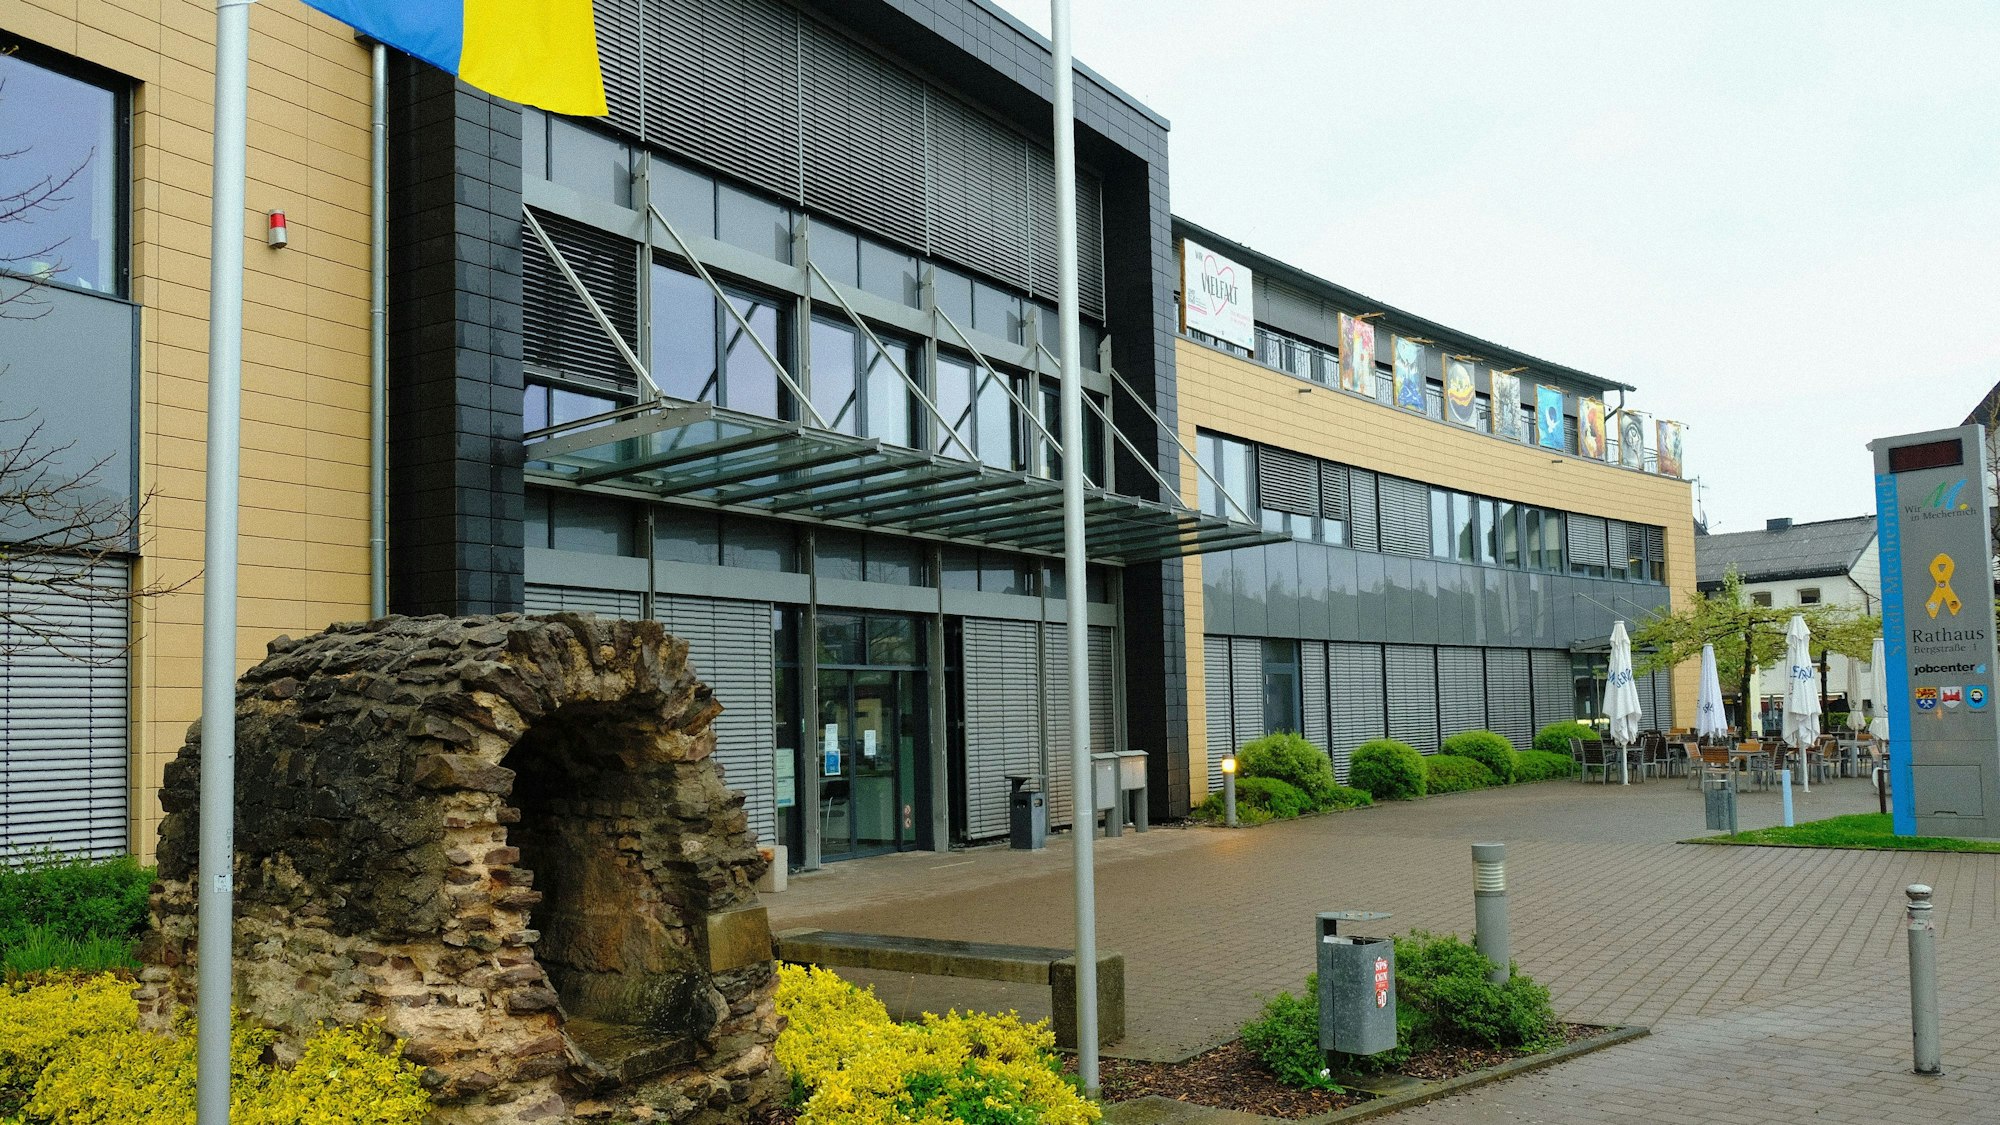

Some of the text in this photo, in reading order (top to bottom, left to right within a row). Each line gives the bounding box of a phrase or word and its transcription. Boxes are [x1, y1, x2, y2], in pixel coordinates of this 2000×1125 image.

[1201, 273, 1239, 305] VIELFALT
[1905, 505, 1922, 514] Wir
[1911, 508, 1977, 522] in Mechernich
[1878, 474, 1902, 657] Stadt Mechernich
[1912, 628, 1985, 643] Rathaus
[1914, 644, 1967, 655] Bergstraße
[1914, 663, 1976, 676] jobcenter
